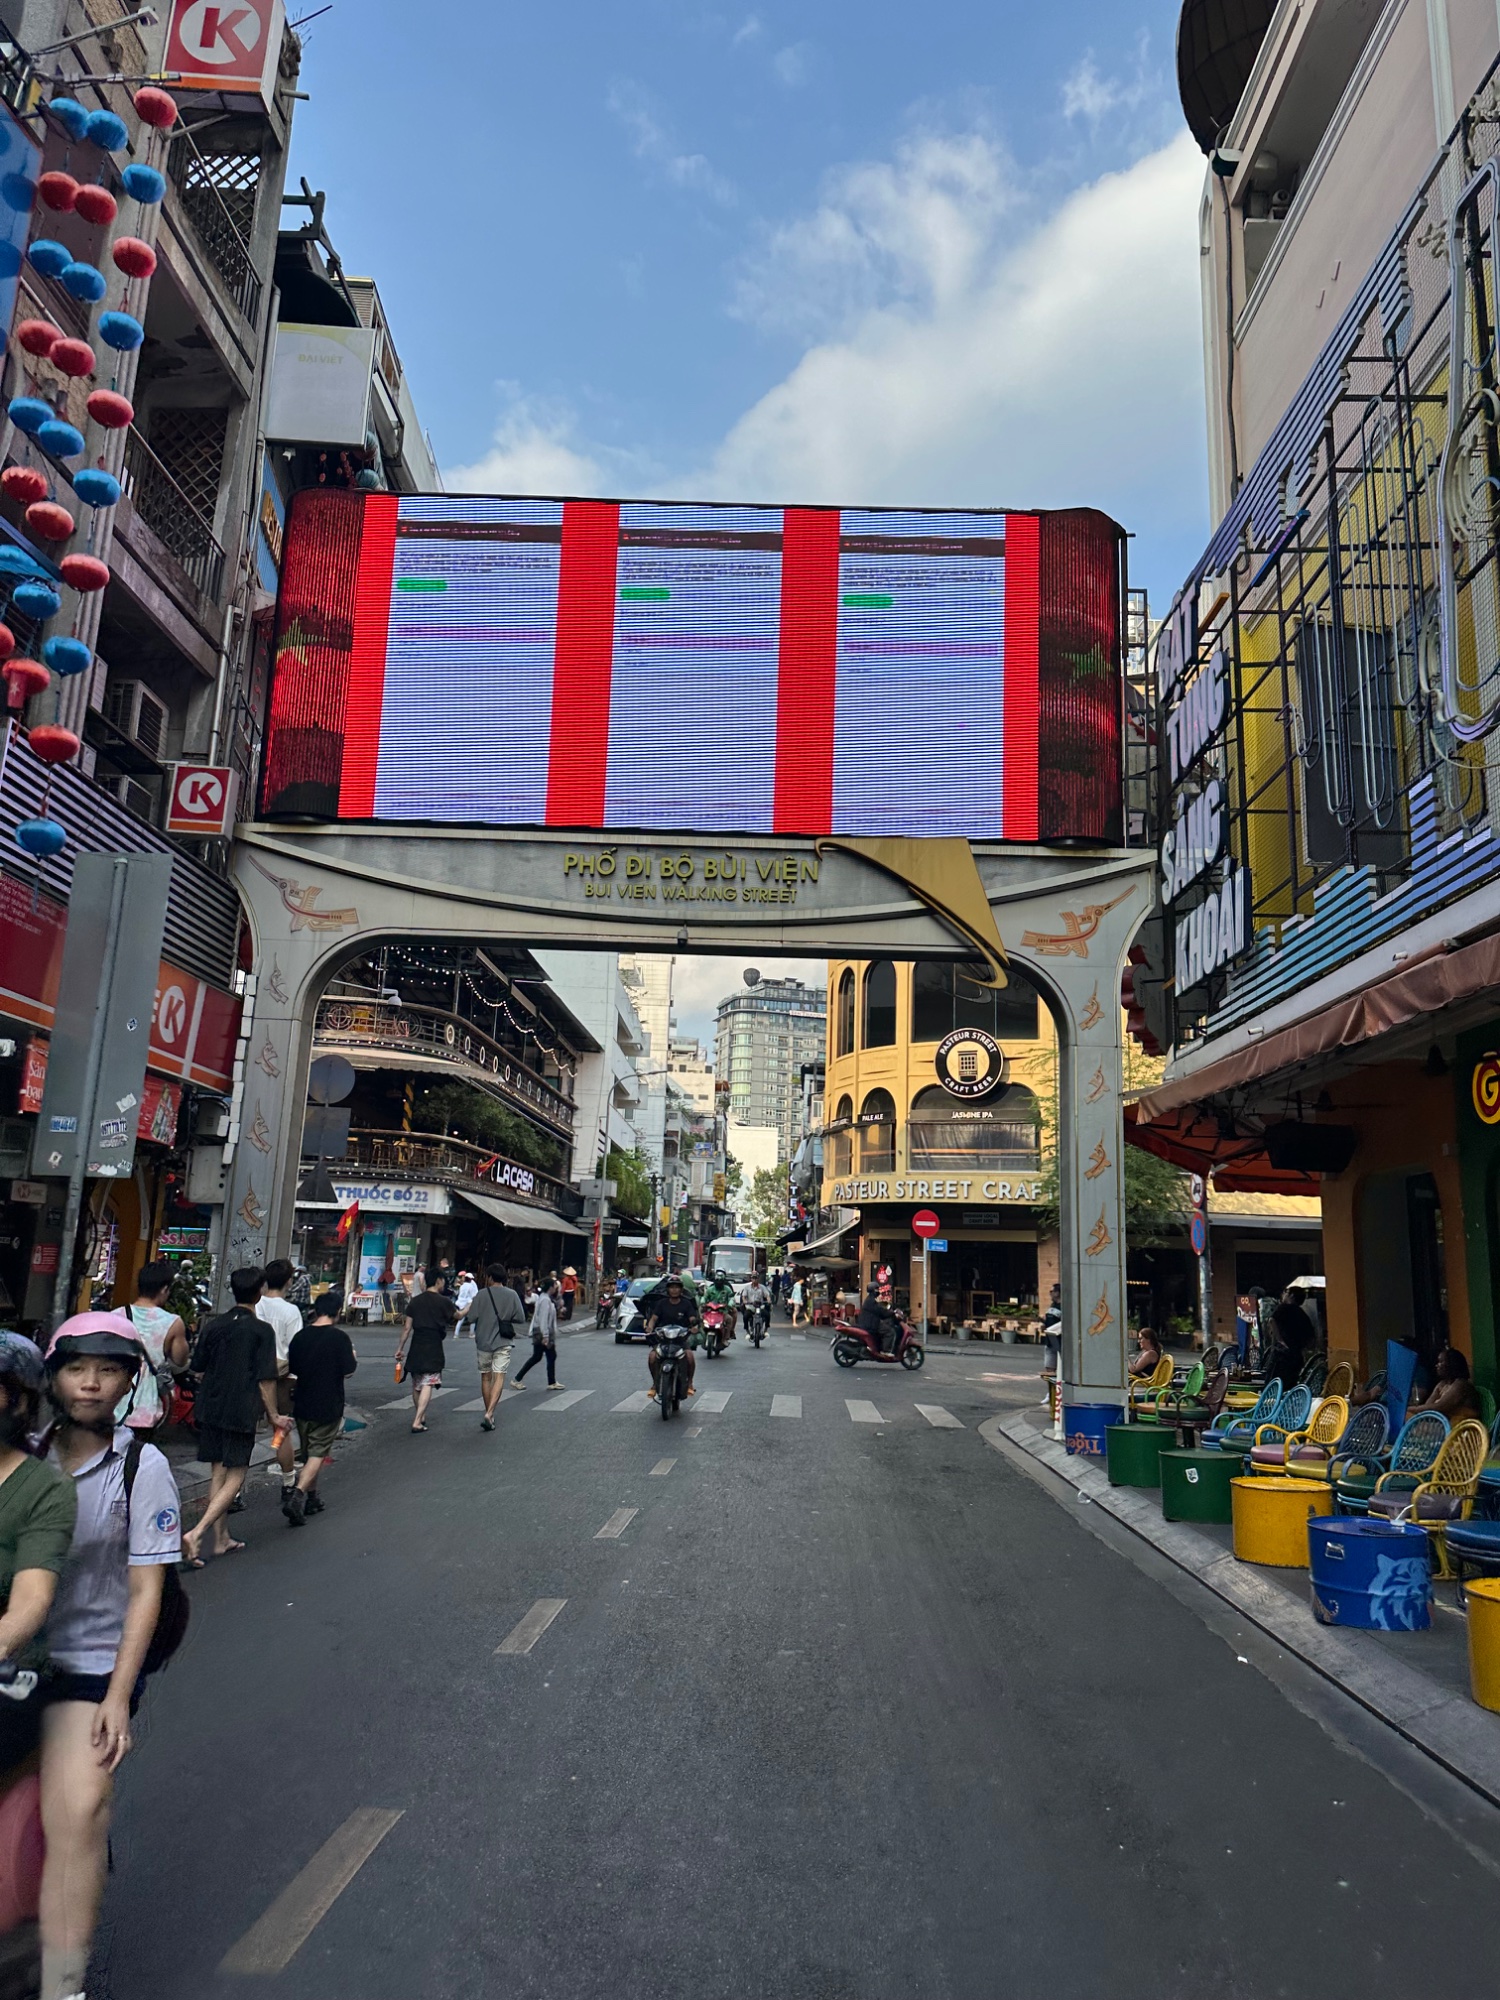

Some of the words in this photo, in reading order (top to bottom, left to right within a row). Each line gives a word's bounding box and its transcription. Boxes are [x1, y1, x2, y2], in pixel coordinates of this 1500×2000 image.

[1167, 649, 1225, 785] TUNG
[1161, 779, 1222, 906] SẢNG
[564, 847, 617, 875] PHỐ
[626, 854, 651, 877] ĐI
[661, 853, 694, 883] BỘ
[704, 852, 746, 880] BÙI
[755, 855, 819, 886] VIỆN
[584, 883, 611, 897] BUI
[617, 884, 656, 899] VIEN
[662, 885, 737, 901] WALKING
[742, 887, 797, 903] STREET
[1174, 855, 1246, 997] KHOÁI
[940, 1031, 970, 1055] PASTEUR
[971, 1032, 997, 1053] STREET
[944, 1077, 969, 1093] CRAFT
[972, 1076, 993, 1092] BEER
[335, 1184, 391, 1200] THUỐC
[393, 1186, 414, 1201] SỐ
[414, 1191, 429, 1202] 22
[834, 1180, 890, 1201] PASTEUR
[895, 1180, 972, 1199] STREET
